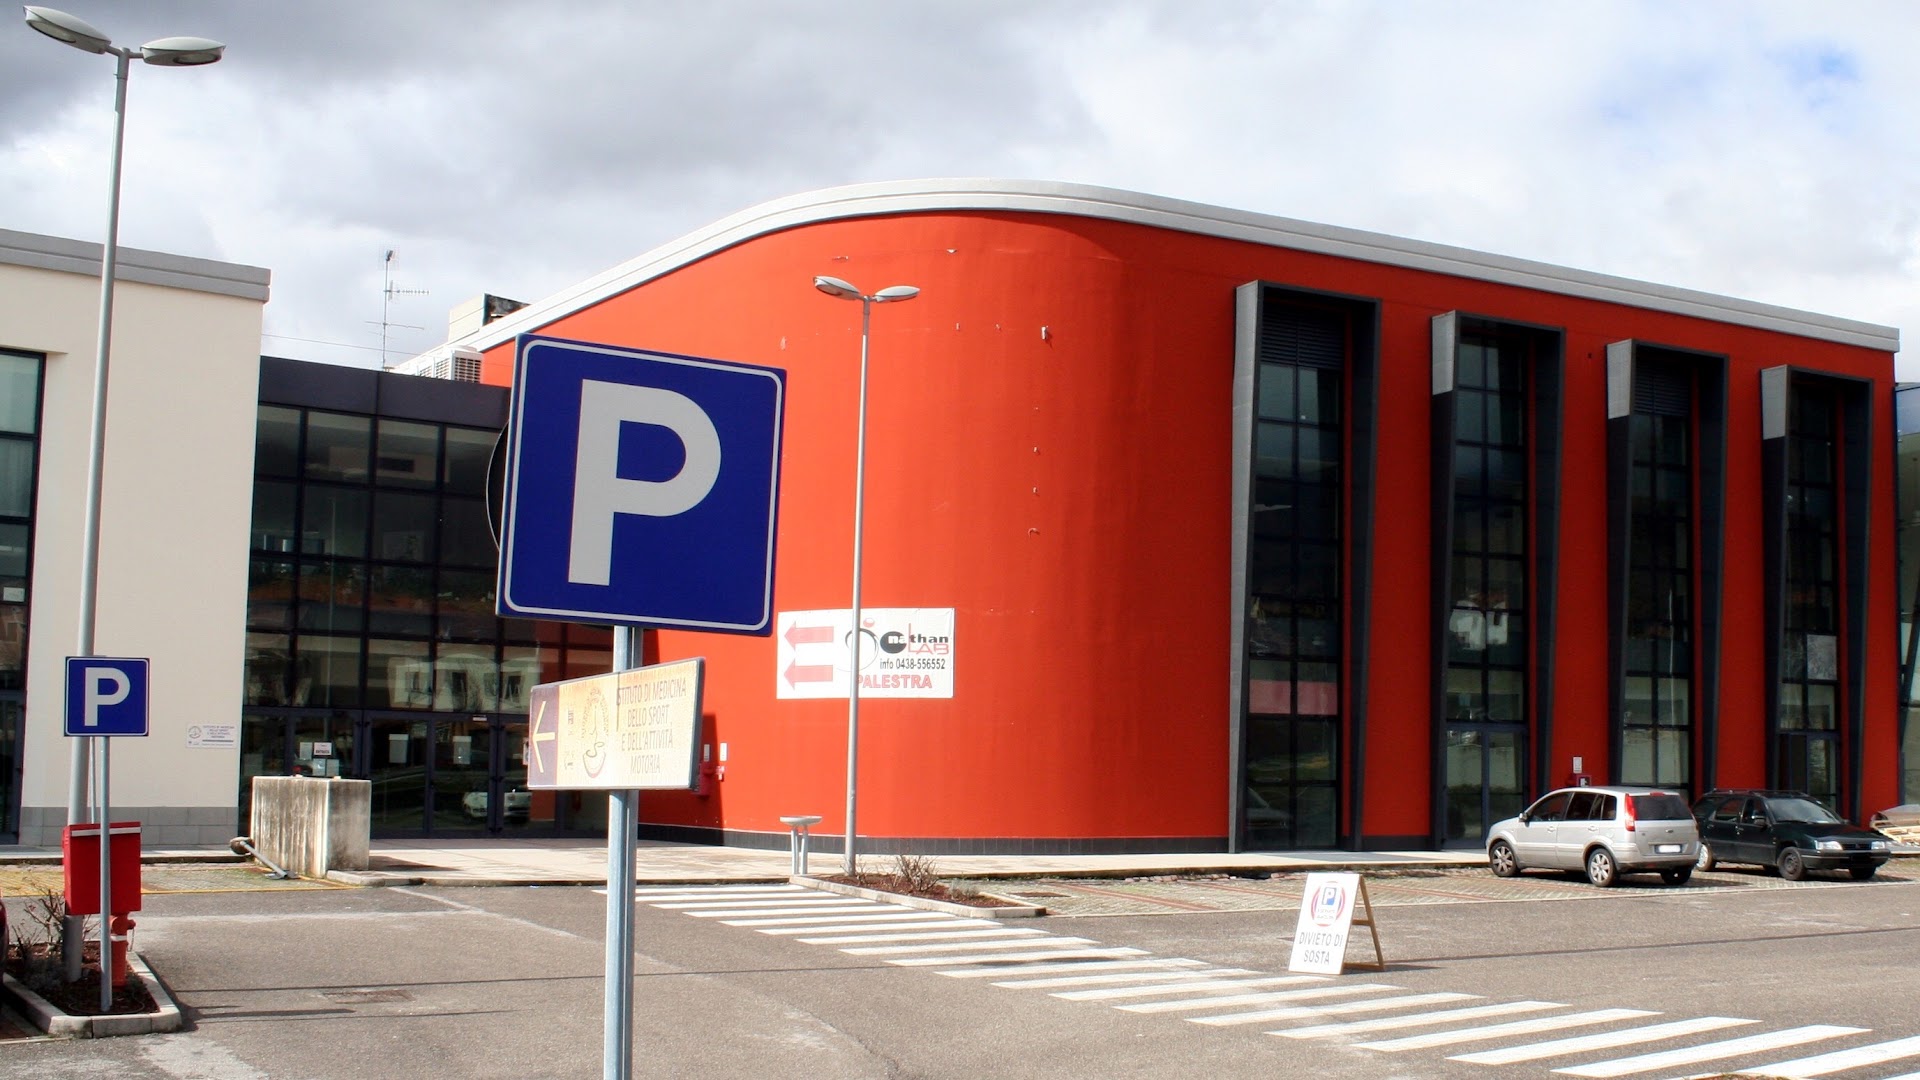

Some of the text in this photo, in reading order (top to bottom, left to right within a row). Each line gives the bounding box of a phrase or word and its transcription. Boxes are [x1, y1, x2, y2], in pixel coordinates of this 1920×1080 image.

[568, 379, 722, 586] P
[908, 623, 950, 655] LAB
[880, 658, 946, 670] info 0438-556552
[84, 667, 131, 726] P
[644, 682, 651, 703] DI
[653, 677, 687, 700] MEDICINA
[627, 704, 670, 728] DELLO SPORT
[621, 733, 626, 752] E
[630, 754, 661, 774] MOTORIA
[1299, 931, 1344, 948] DIVIETO DI
[1303, 950, 1330, 965] SOSTA
